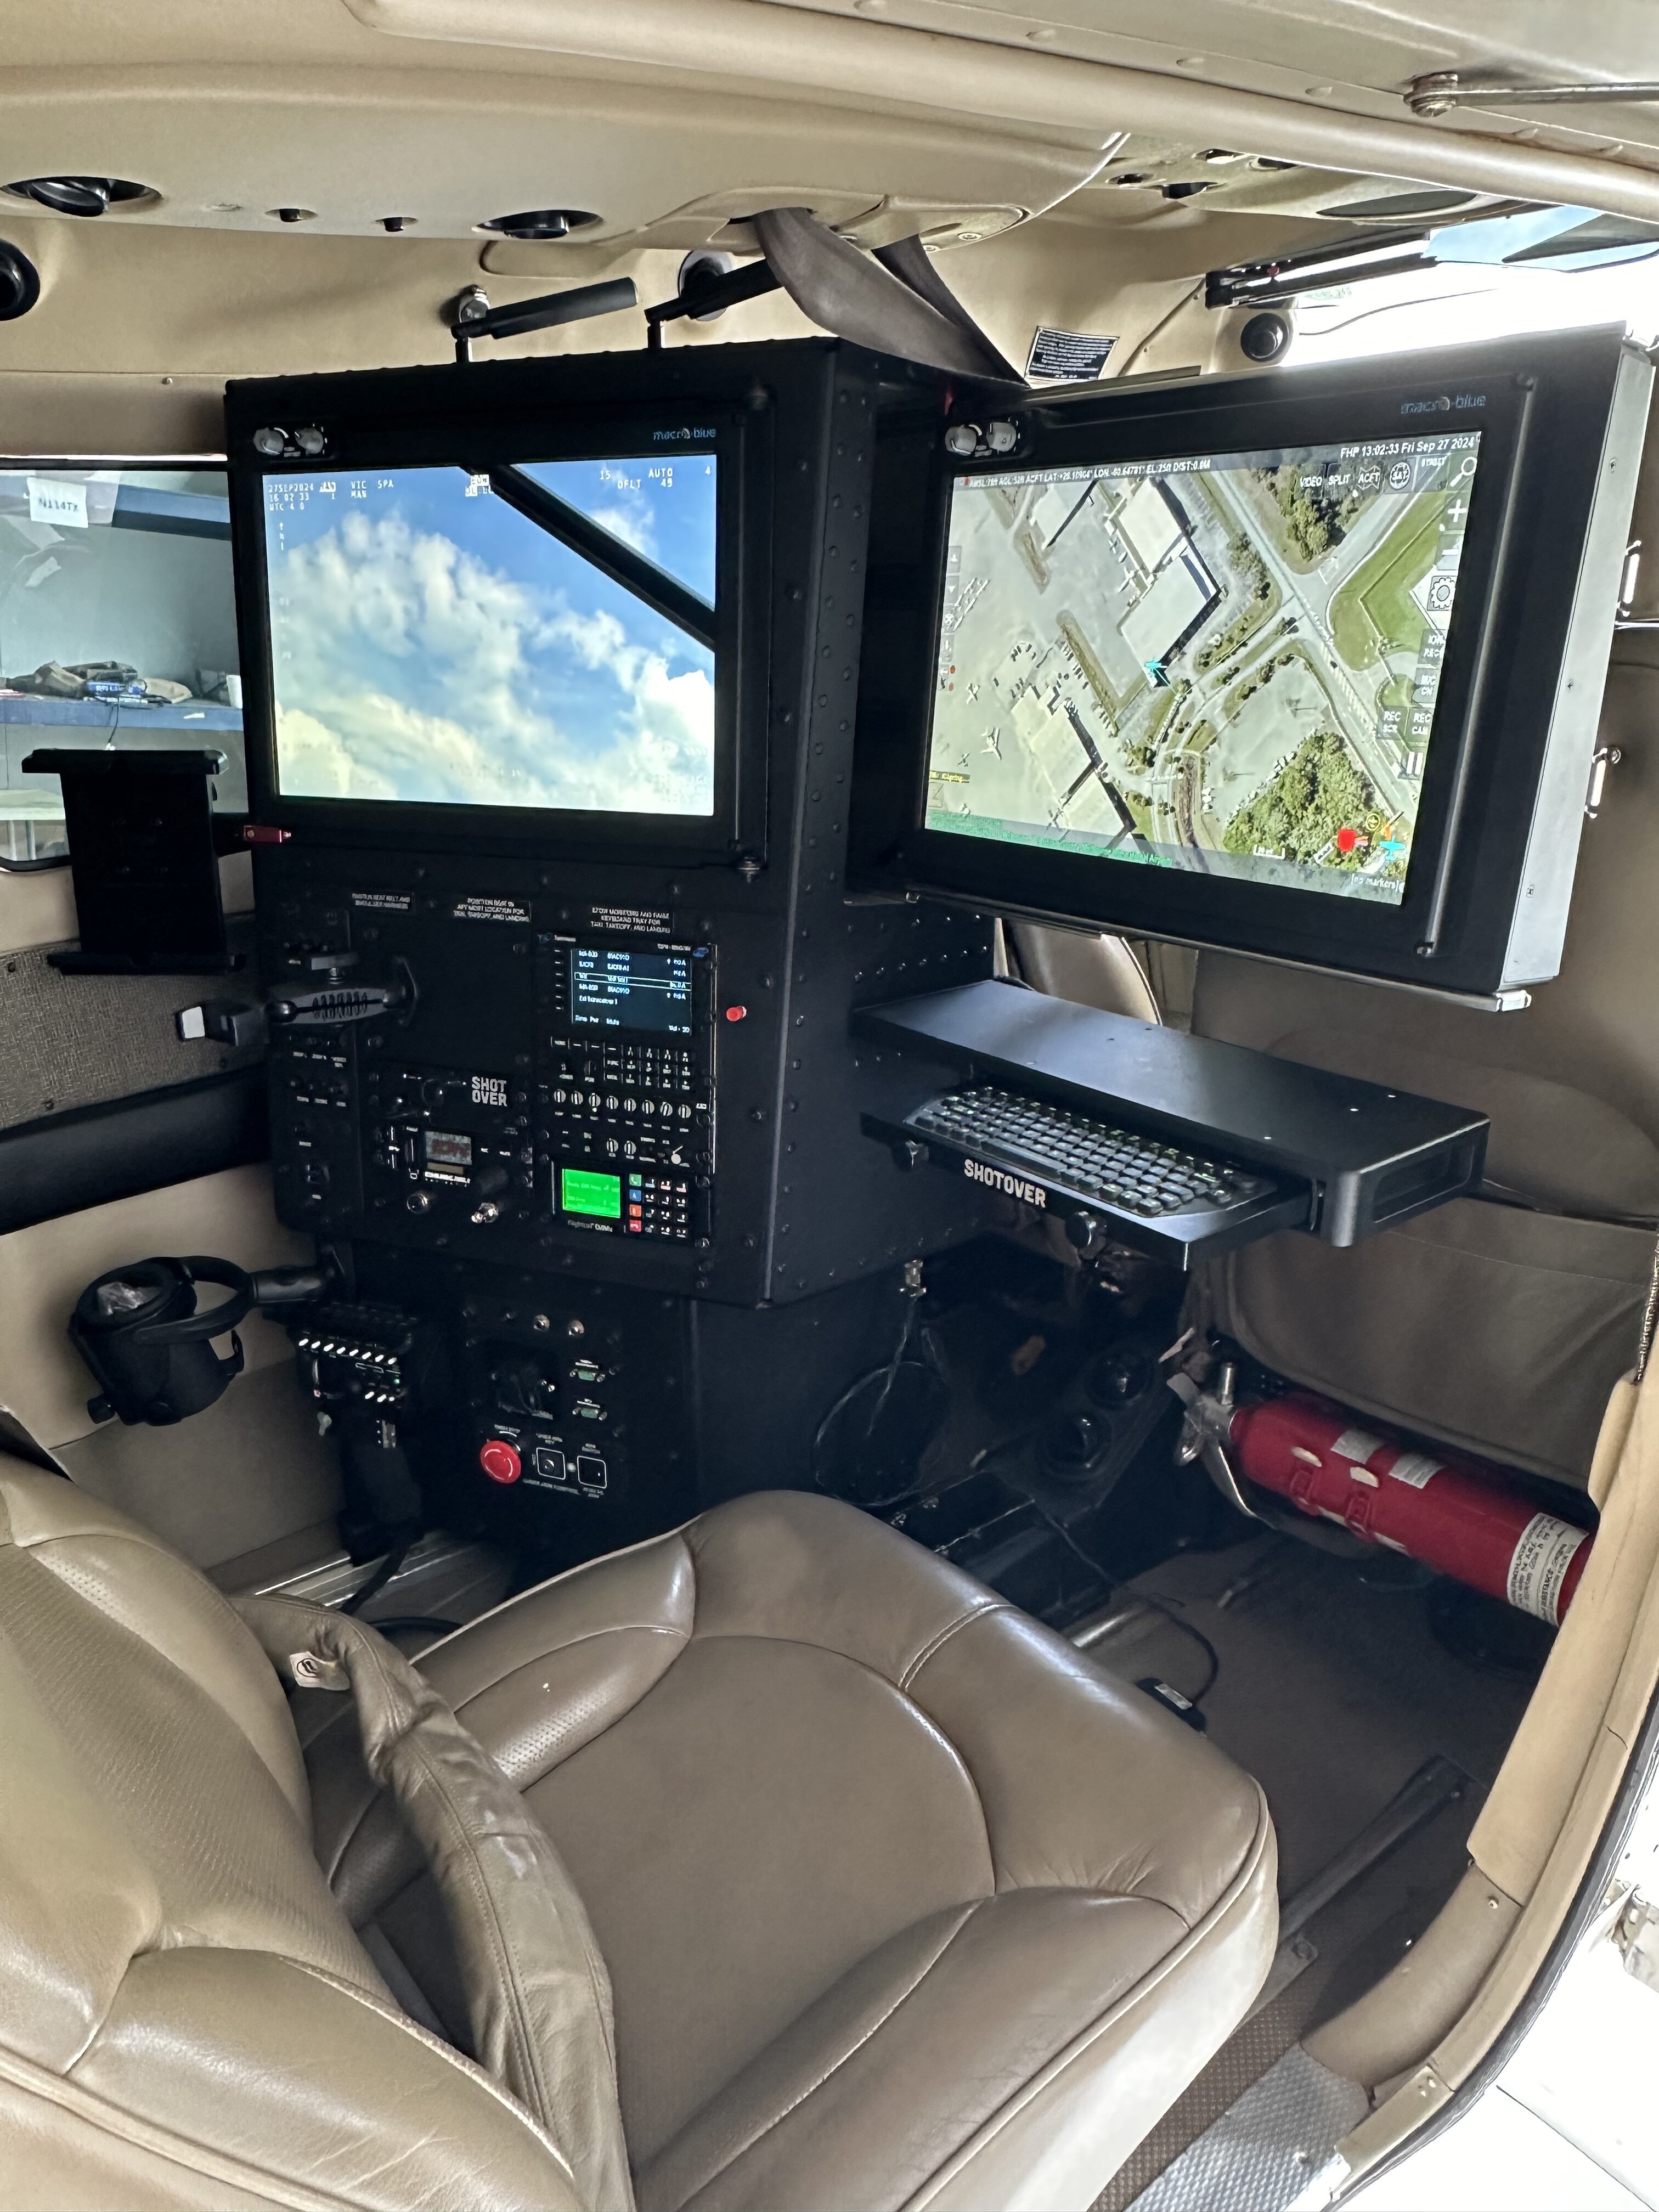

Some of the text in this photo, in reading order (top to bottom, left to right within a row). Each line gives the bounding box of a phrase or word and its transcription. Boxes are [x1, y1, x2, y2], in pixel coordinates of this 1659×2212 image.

[1340, 436, 1475, 459] FHP 13:02:33 Fri Sep 27 2024
[648, 467, 673, 478] AUTO
[1300, 475, 1323, 487] VIDEO
[1328, 473, 1351, 486] SPLIT
[1358, 472, 1380, 484] ACFT
[377, 479, 394, 489] SPA
[617, 478, 673, 489] DFLT 49
[1383, 711, 1432, 723] REC REC
[471, 1076, 507, 1093] SHOT
[472, 1090, 508, 1107] OVER
[964, 1159, 1046, 1208] SHOTOVER
